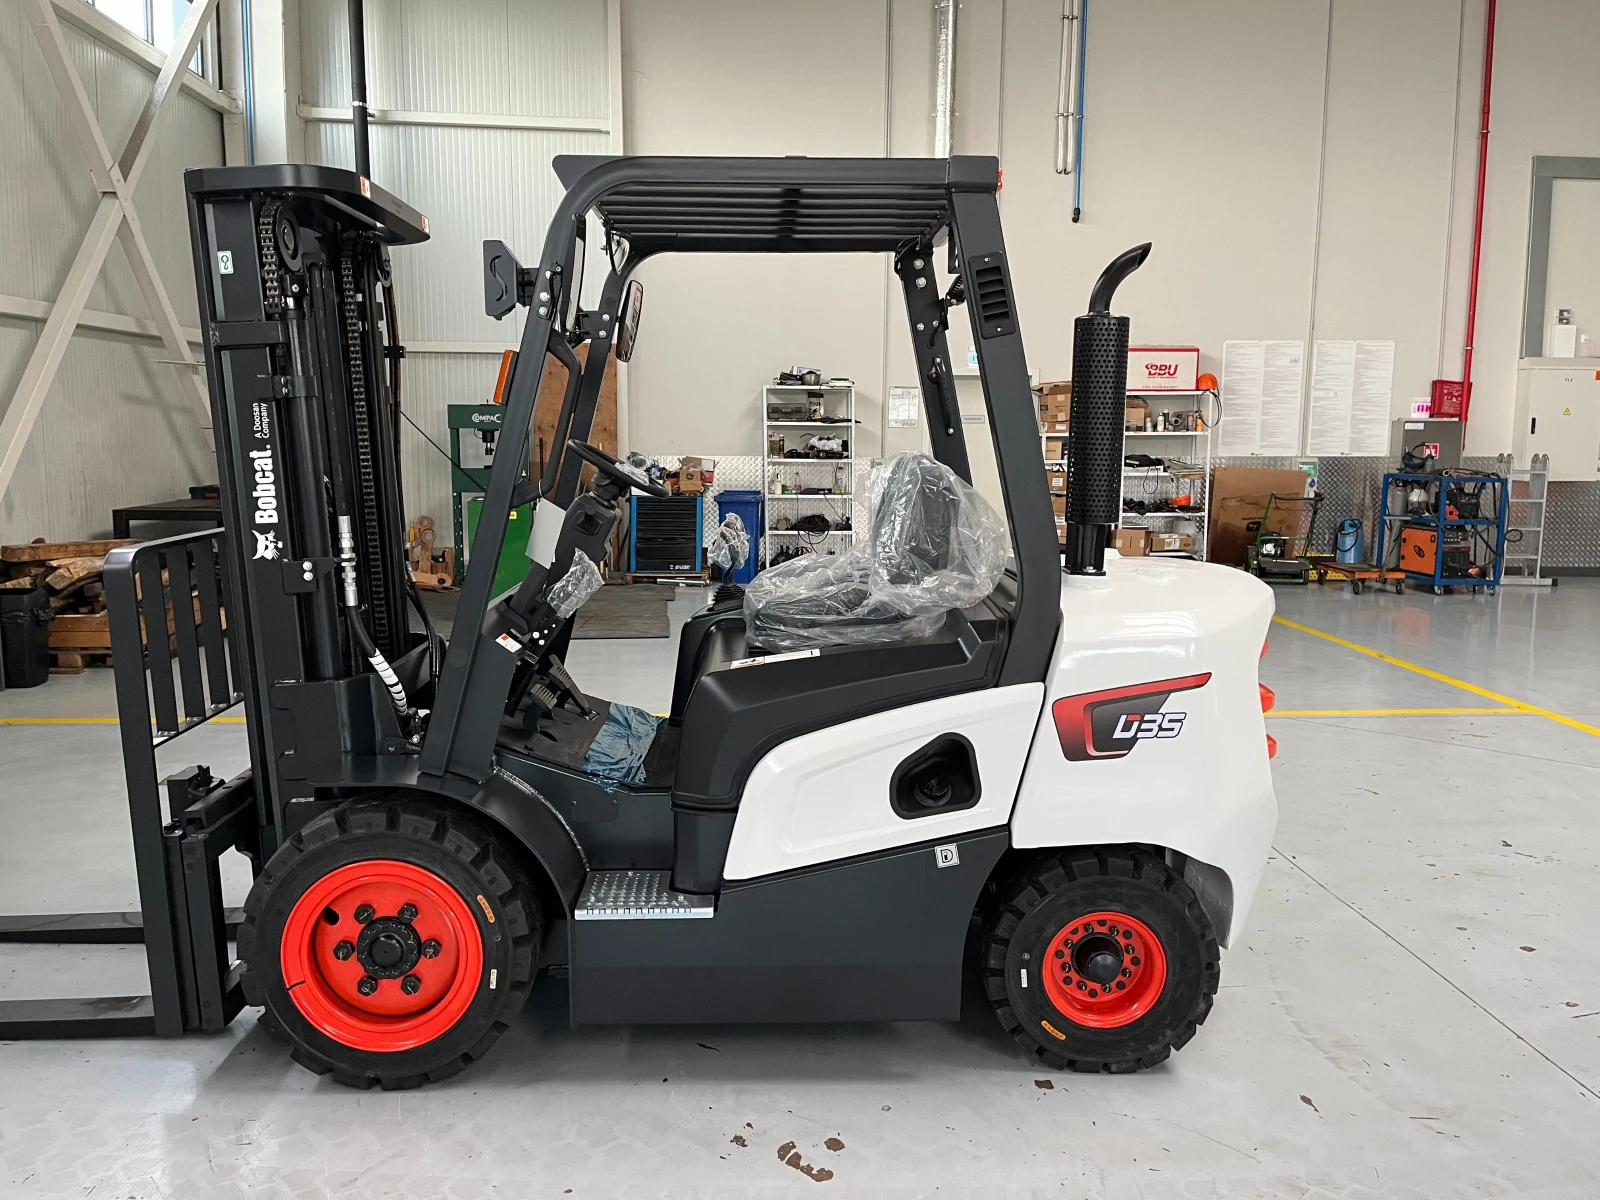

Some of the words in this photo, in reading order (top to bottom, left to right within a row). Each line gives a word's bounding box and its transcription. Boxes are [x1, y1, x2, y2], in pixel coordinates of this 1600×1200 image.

[253, 403, 261, 431] Doosan
[260, 403, 270, 439] Company
[1112, 713, 1187, 739] D35
